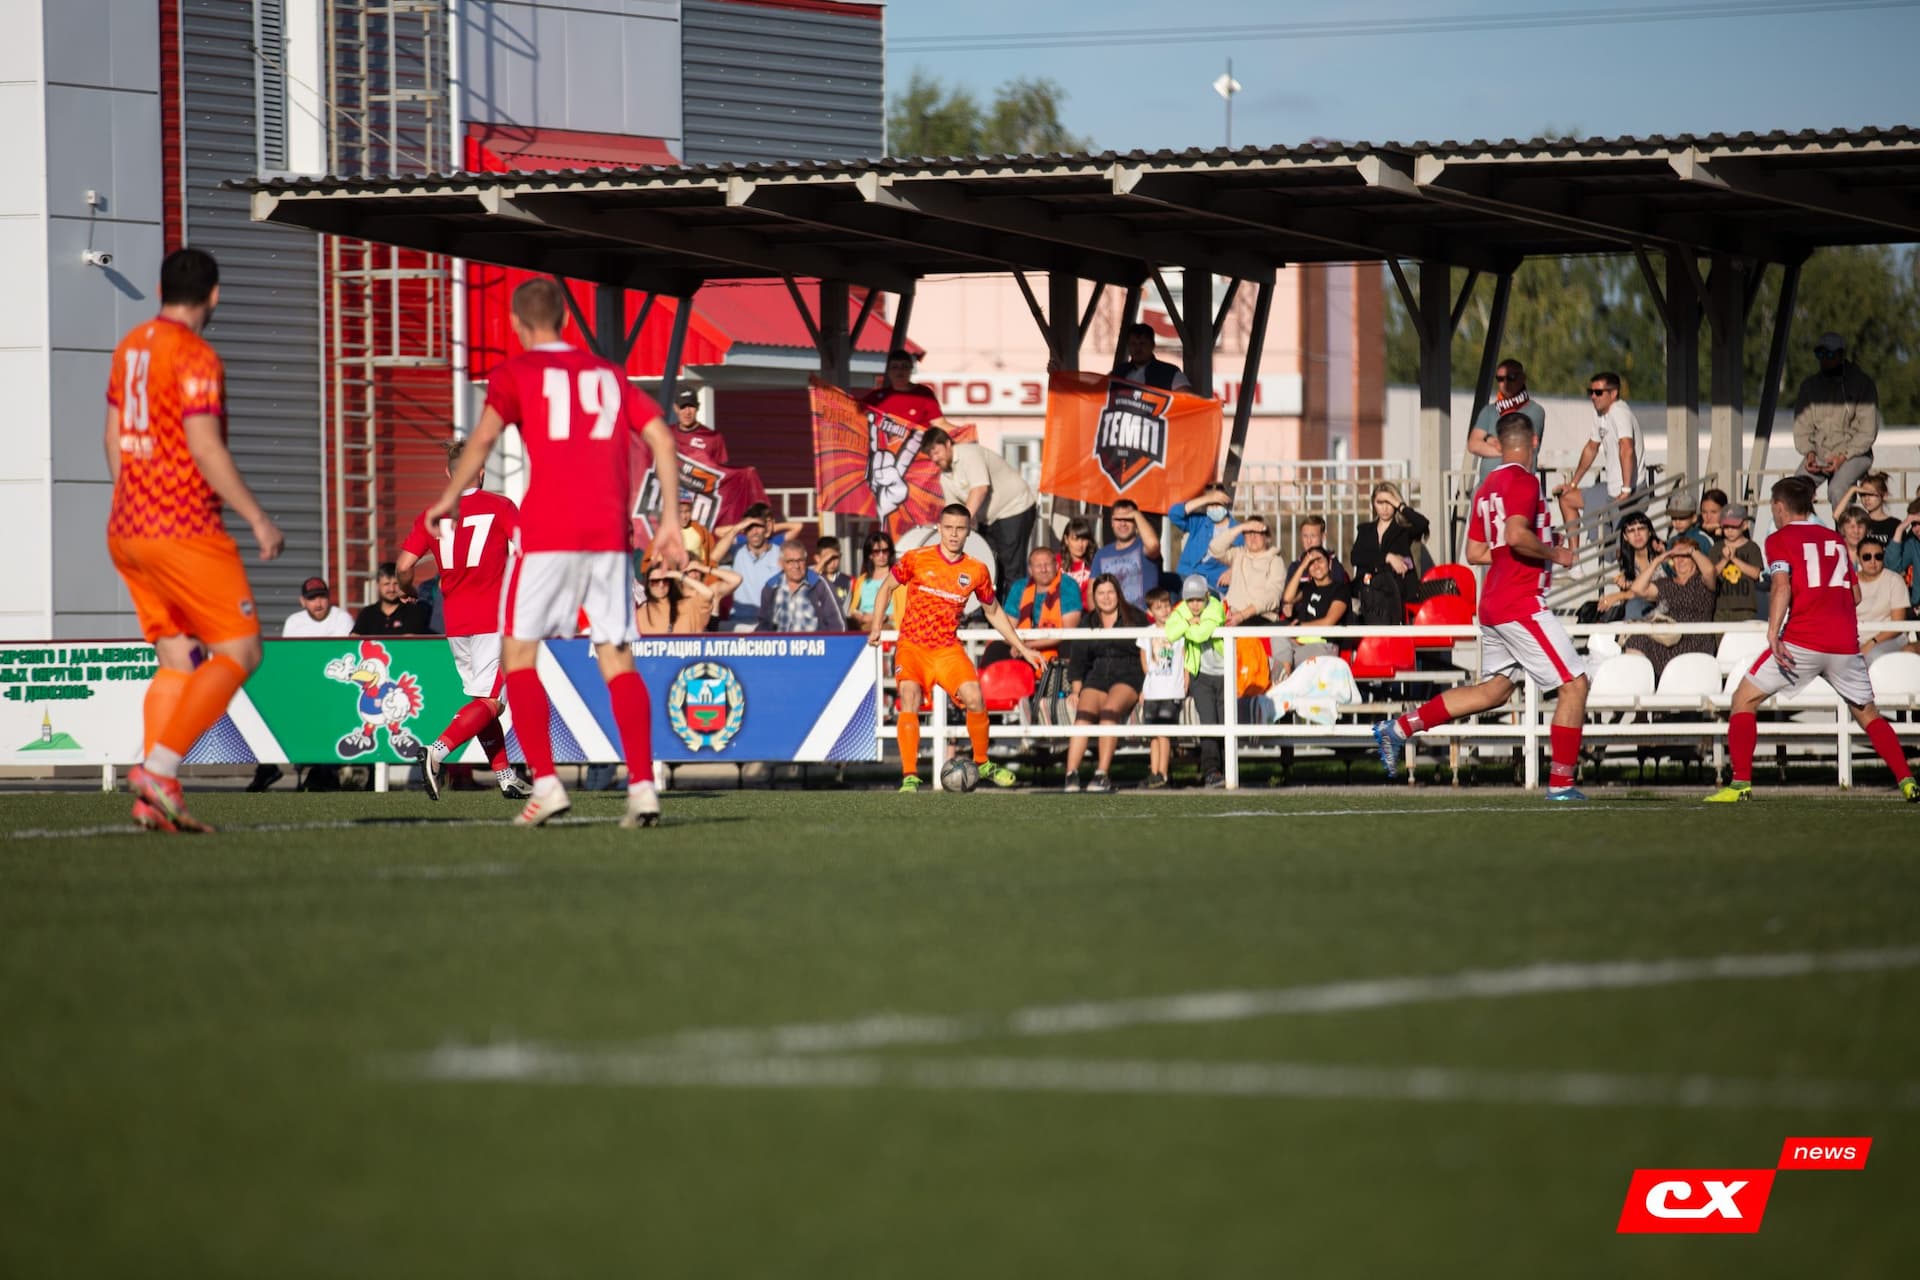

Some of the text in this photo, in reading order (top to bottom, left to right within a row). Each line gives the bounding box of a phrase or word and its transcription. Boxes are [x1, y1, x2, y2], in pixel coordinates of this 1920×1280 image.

[124, 348, 151, 432] 13
[542, 367, 622, 441] 19
[1101, 411, 1160, 456] ТЕМП
[437, 513, 495, 569] 17
[1802, 540, 1851, 589] 12
[70, 647, 155, 666] ДАЛЬНЕВОСТО
[588, 638, 825, 659] АНИСТРАЦИЯ АЛТАЙСКОГО КРАЯ
[86, 666, 102, 681] ПО
[105, 665, 158, 681] ФУТБОЛ
